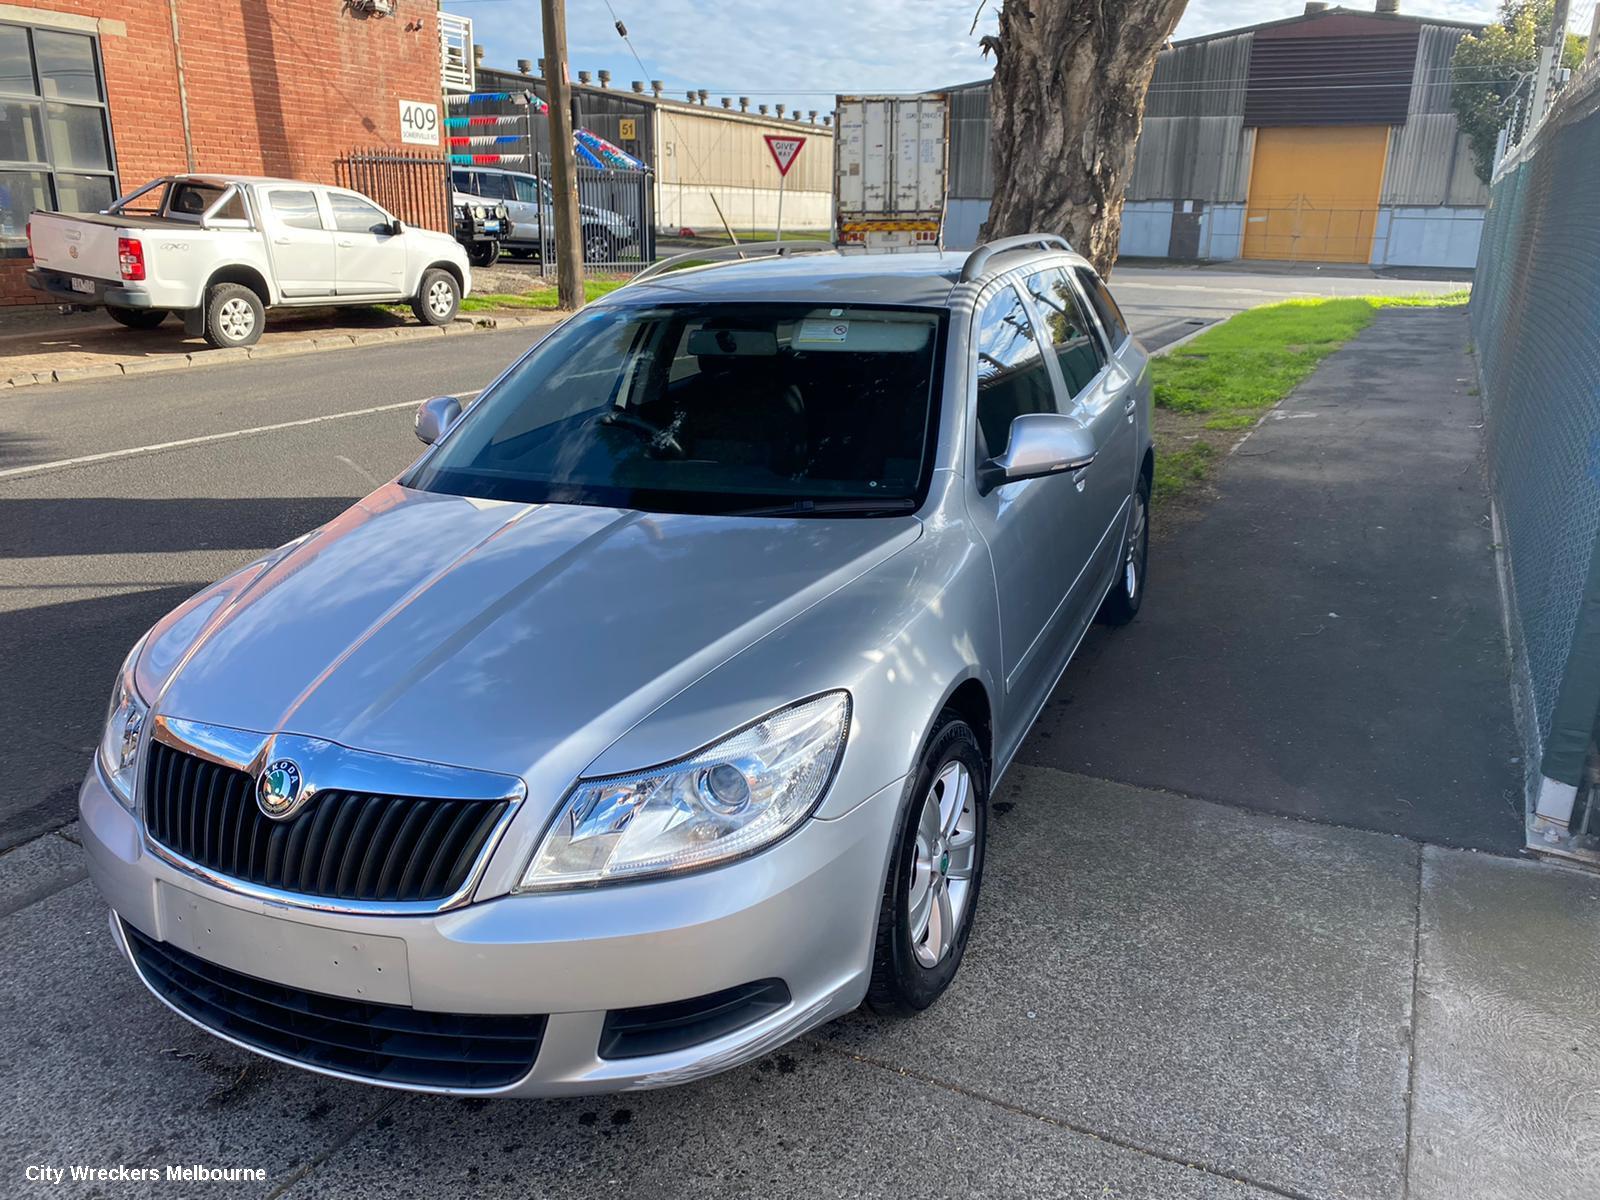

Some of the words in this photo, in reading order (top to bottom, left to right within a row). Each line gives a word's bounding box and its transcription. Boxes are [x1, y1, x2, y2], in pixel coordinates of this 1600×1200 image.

[402, 106, 436, 130] 409
[622, 123, 633, 135] 51
[666, 141, 676, 157] 51
[775, 142, 794, 150] GIVE
